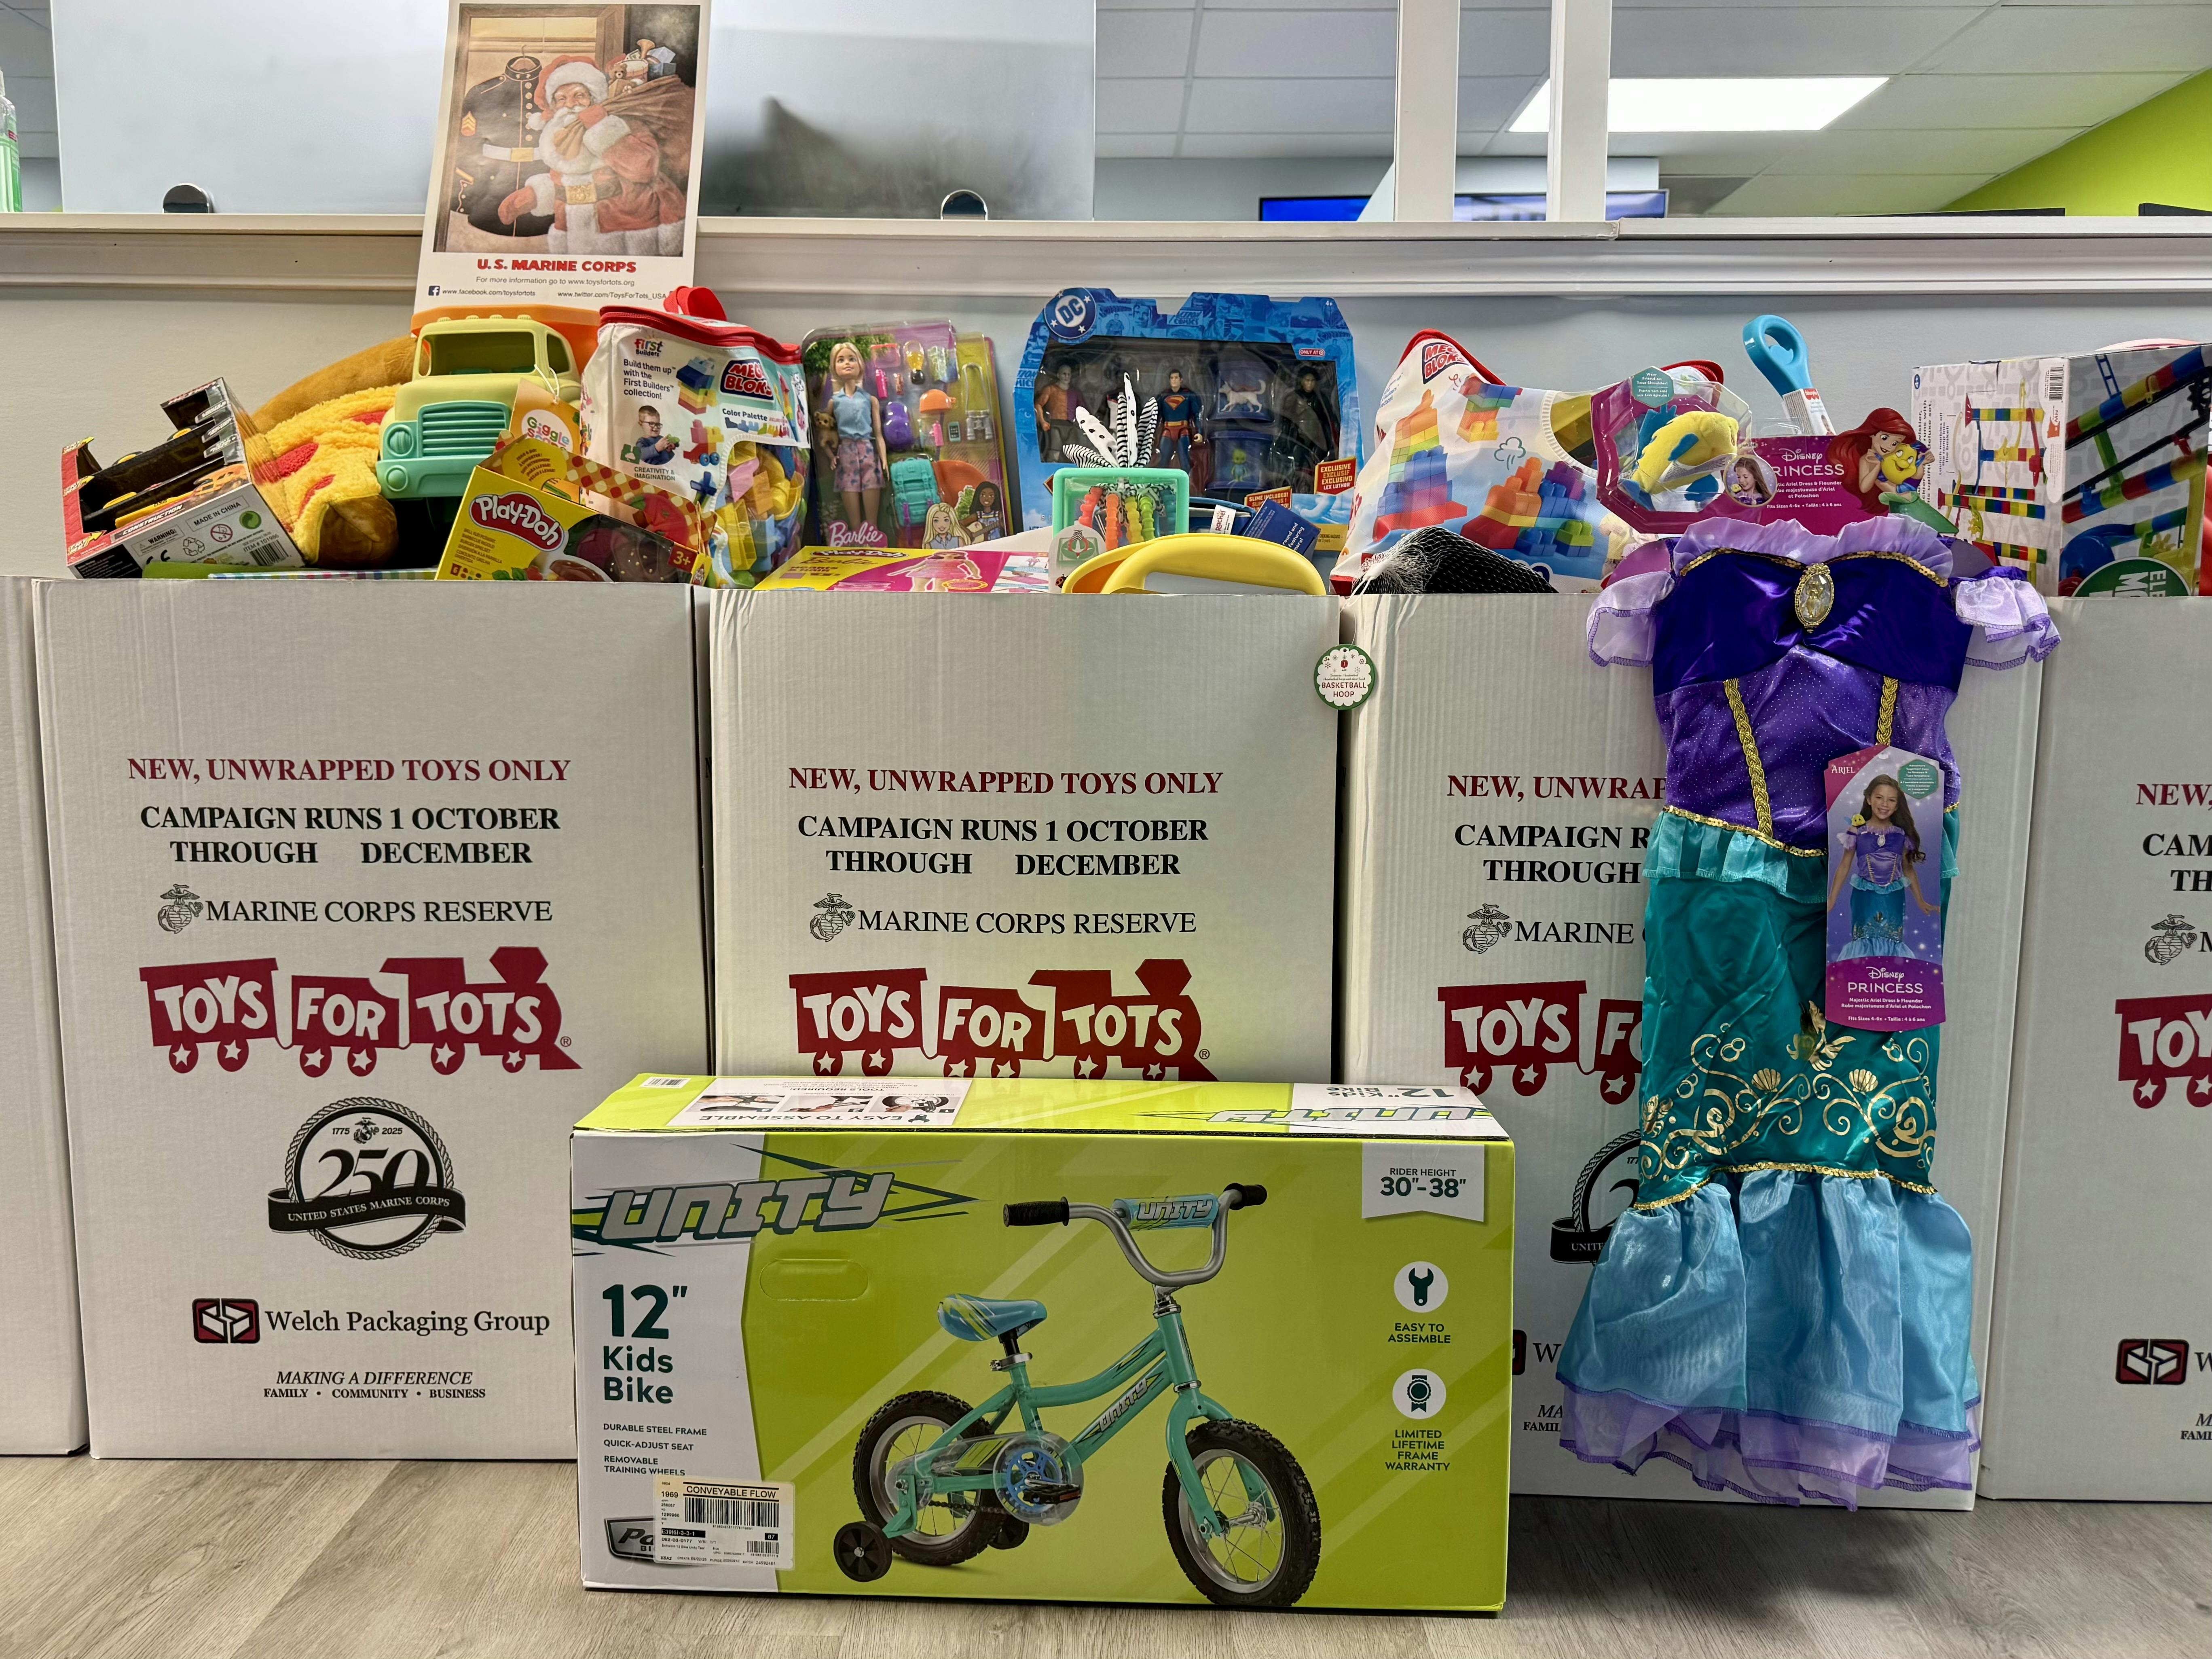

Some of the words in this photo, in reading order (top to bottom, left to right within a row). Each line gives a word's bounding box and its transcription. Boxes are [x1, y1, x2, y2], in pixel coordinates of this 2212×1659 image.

[512, 260, 577, 272] MARINE
[582, 260, 637, 273] CORPS
[568, 278, 635, 287] www.toysfortots.org
[442, 288, 536, 296] www.facebook.com/toysfortots
[558, 290, 666, 300] www.twitter.com/ToysForTots_USA
[1058, 298, 1083, 324] DC
[1425, 345, 1458, 362] MEG
[624, 359, 641, 368] Build
[643, 362, 661, 373] them
[729, 363, 766, 379] MEG
[624, 369, 638, 377] with
[641, 371, 652, 379] the
[624, 378, 638, 387] First
[624, 388, 662, 400] collection!
[723, 408, 741, 418] Color
[742, 411, 768, 421] Palette
[527, 417, 570, 447] Giggle
[634, 466, 669, 474] CREATIVITY
[1320, 463, 1351, 472] EXCLUSIVE
[1323, 470, 1349, 478] EXCLUSIF
[1772, 464, 1845, 477] RINCESS
[1322, 475, 1352, 485] EXCLUSIVO
[122, 504, 183, 536] CONSTRUCTION
[193, 514, 214, 526] MADE
[221, 502, 241, 515] CHINA
[474, 494, 560, 547] Play-Doh
[148, 528, 176, 544] WARNING!
[829, 522, 883, 547] Barbie
[1282, 530, 1293, 545] round
[1288, 527, 1305, 548] featuring
[243, 544, 256, 553] ITEM
[673, 551, 691, 565] 3+
[127, 758, 201, 785] NEW,
[206, 758, 395, 781] UNWRAPPED
[402, 759, 480, 781] TOYS
[489, 759, 571, 782] ONLY
[1831, 764, 1855, 774] ARIEL
[788, 767, 861, 794] NEW,
[869, 768, 1052, 794] UNWRAPPED
[1061, 772, 1137, 794] TOYS
[1144, 772, 1224, 794] ONLY
[1447, 775, 1524, 802] NEW,
[140, 806, 298, 830] CAMPAIGN
[304, 807, 382, 830] RUNS
[390, 807, 404, 829] 1
[412, 807, 560, 830] OCTOBER
[797, 815, 954, 841] CAMPAIGN
[961, 819, 1037, 842] RUNS
[1046, 820, 1057, 842] 1
[1066, 819, 1209, 842] OCTOBER
[1455, 824, 1623, 849] CAMPAIGN
[170, 840, 318, 864] THROUGH
[361, 842, 533, 864] DECEMBER
[826, 850, 973, 875] THROUGH
[1015, 853, 1181, 876] DECEMBER
[1483, 859, 1641, 884] THROUGH
[206, 900, 318, 922] MARINE
[324, 900, 416, 923] CORPS
[423, 901, 552, 922] RESERVE
[858, 910, 969, 933] MARINE
[975, 911, 1065, 935] CORPS
[1073, 912, 1197, 934] RESERVE
[1514, 920, 1634, 944] MARINE
[1848, 982, 1923, 994] PRINCESS
[154, 975, 269, 1034] TOYS
[296, 987, 386, 1041] FOR
[416, 990, 541, 1044] TOTS
[802, 984, 915, 1042] TOYS
[942, 998, 1032, 1052] FOR
[1062, 1003, 1183, 1056] TOTS
[1451, 998, 1571, 1057] TOYS
[1207, 1107, 1474, 1123] UNITY
[317, 1147, 430, 1198] 250
[1389, 1168, 1418, 1177] RIDER
[1420, 1168, 1456, 1177] HEIGHT
[288, 1211, 327, 1222] UNITED
[330, 1203, 367, 1217] STATES
[370, 1196, 412, 1210] MARINE
[415, 1196, 450, 1208] CORPS
[598, 1172, 895, 1242] UNITY
[1137, 1198, 1213, 1221] UNITY
[602, 1284, 687, 1339] 12"
[264, 1310, 340, 1331] Welch
[347, 1311, 468, 1336] Packaging
[474, 1312, 550, 1336] Group
[1395, 1323, 1425, 1331] EASY
[1428, 1323, 1444, 1332] TO
[1387, 1334, 1451, 1343] ASSEMBLE
[603, 1345, 673, 1373] Kids
[276, 1371, 345, 1385] MAKING
[348, 1371, 359, 1384] A
[363, 1371, 473, 1385] DIFFERENCE
[264, 1388, 309, 1398] FAMILY
[332, 1388, 408, 1398] COMMUNITY
[429, 1388, 486, 1399] BUSINESS
[604, 1376, 674, 1404] Bike
[603, 1423, 645, 1433] DURABLE
[646, 1425, 673, 1435] STEEL
[675, 1427, 707, 1436] FRAME
[1395, 1429, 1442, 1439] LIMITED
[1523, 1422, 1561, 1432] FAMIL
[603, 1439, 669, 1450] QUICK-ADJUST
[671, 1442, 694, 1451] SEAT
[1391, 1440, 1445, 1450] LIFETIME
[604, 1455, 658, 1465] REMOVABLE
[1398, 1451, 1438, 1460] FRAME
[604, 1465, 647, 1475] TRAINING
[648, 1468, 685, 1477] WHEELS
[1385, 1462, 1451, 1471] WARRANTY
[687, 1485, 748, 1497] CONVEYABLE
[750, 1490, 776, 1498] FLOW
